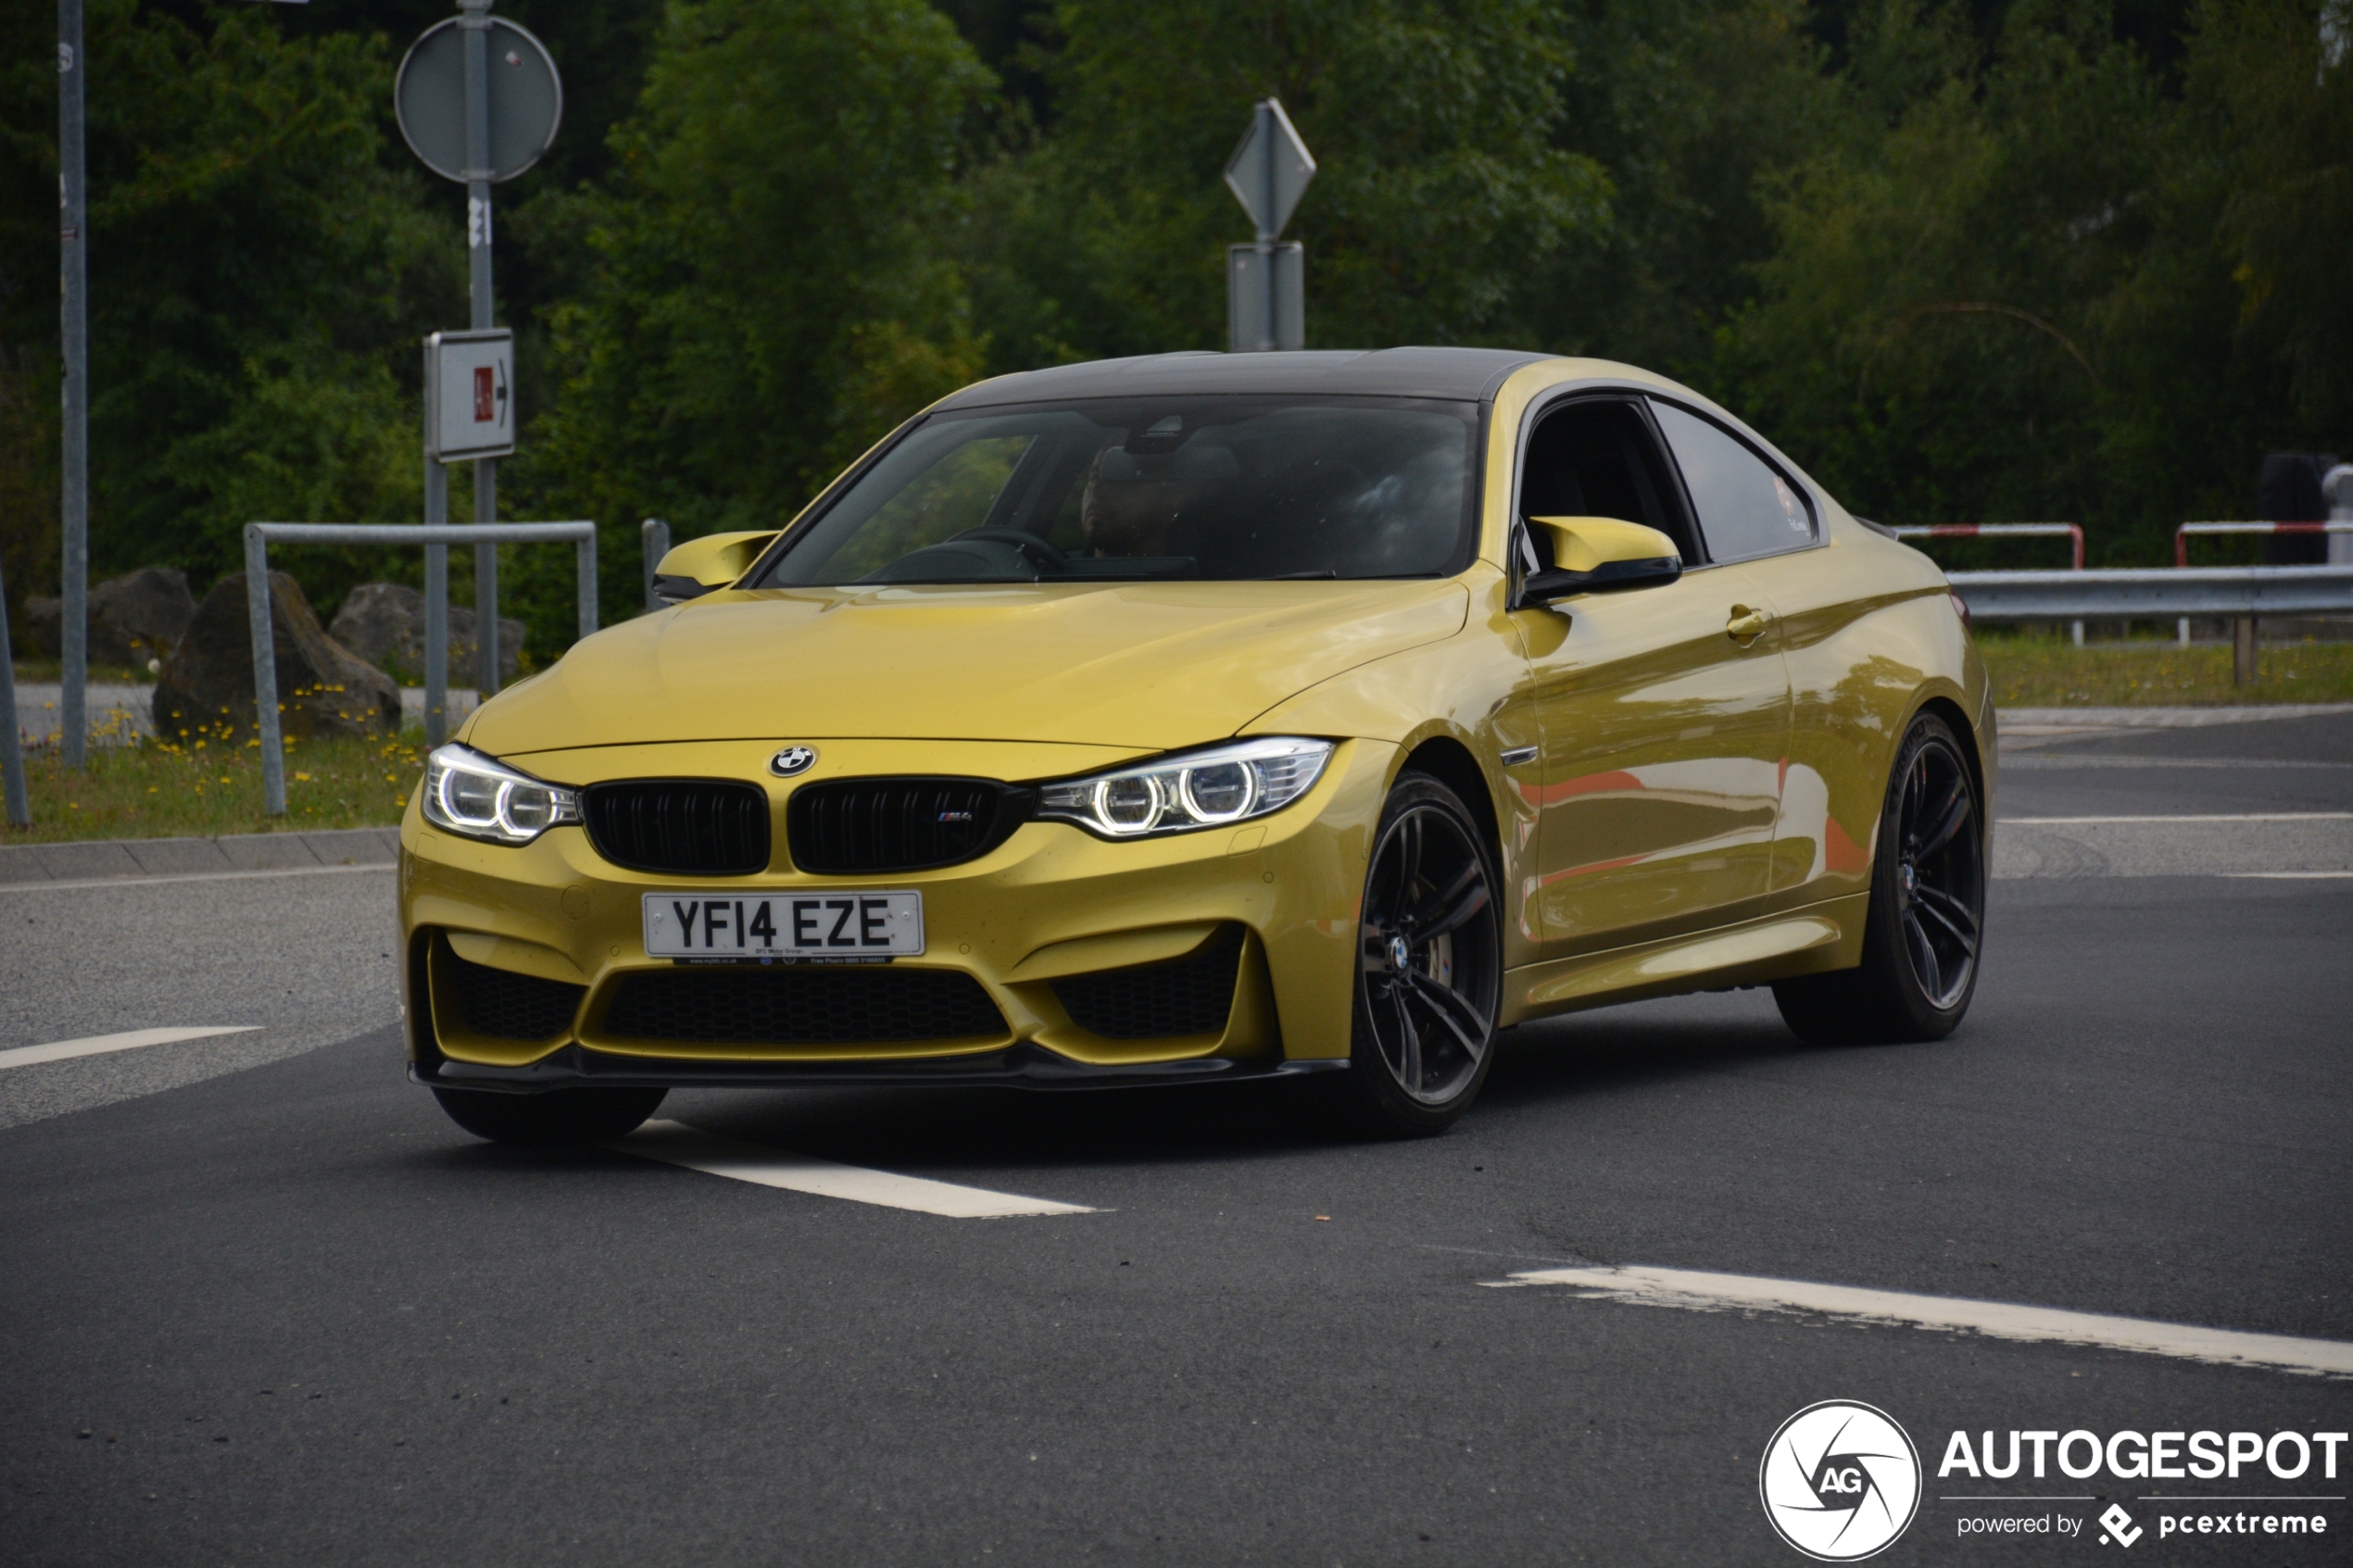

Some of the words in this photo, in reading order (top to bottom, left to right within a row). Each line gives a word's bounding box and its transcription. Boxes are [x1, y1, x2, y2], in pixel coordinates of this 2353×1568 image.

[949, 812, 973, 822] M4
[673, 901, 776, 947] YF14
[793, 899, 889, 947] EZE
